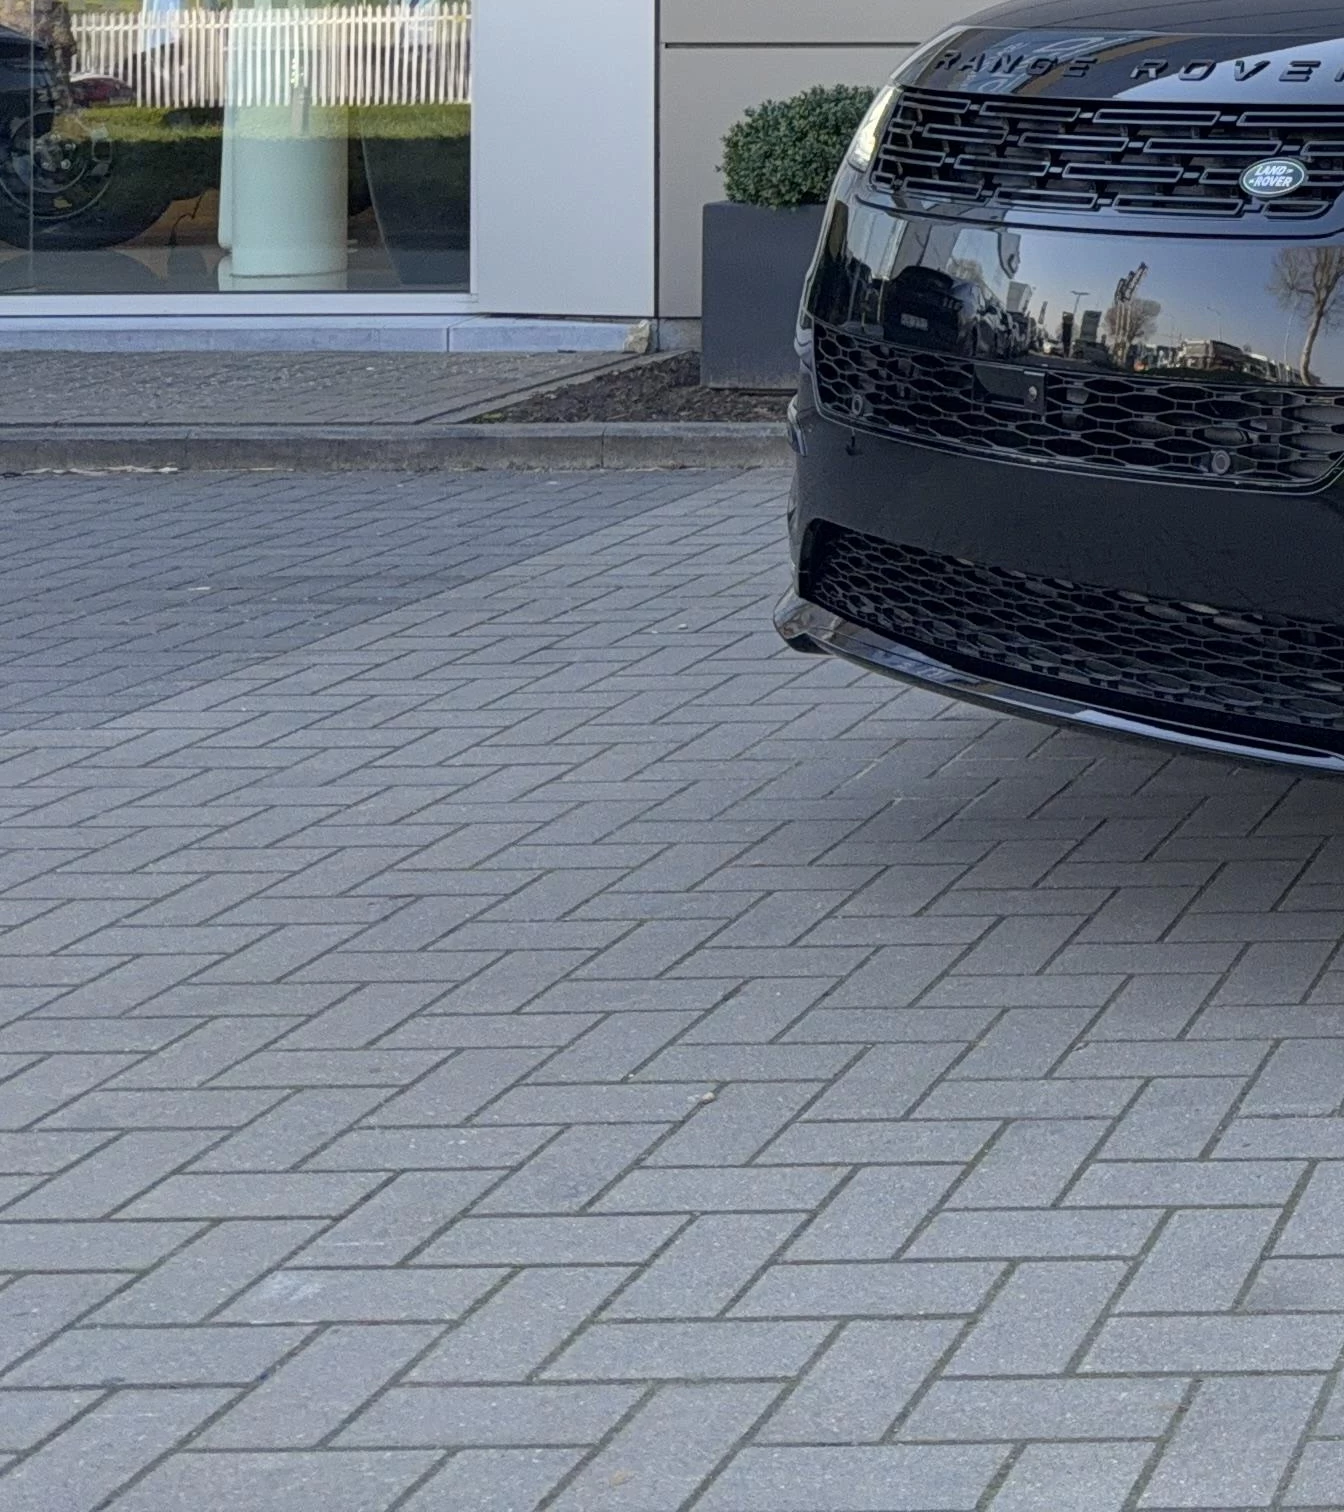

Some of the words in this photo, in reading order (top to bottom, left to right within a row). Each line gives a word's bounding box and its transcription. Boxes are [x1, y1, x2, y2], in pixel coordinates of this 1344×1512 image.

[933, 48, 1099, 79] RANGE
[1254, 165, 1288, 176] LAND
[1252, 175, 1293, 188] ROVER
